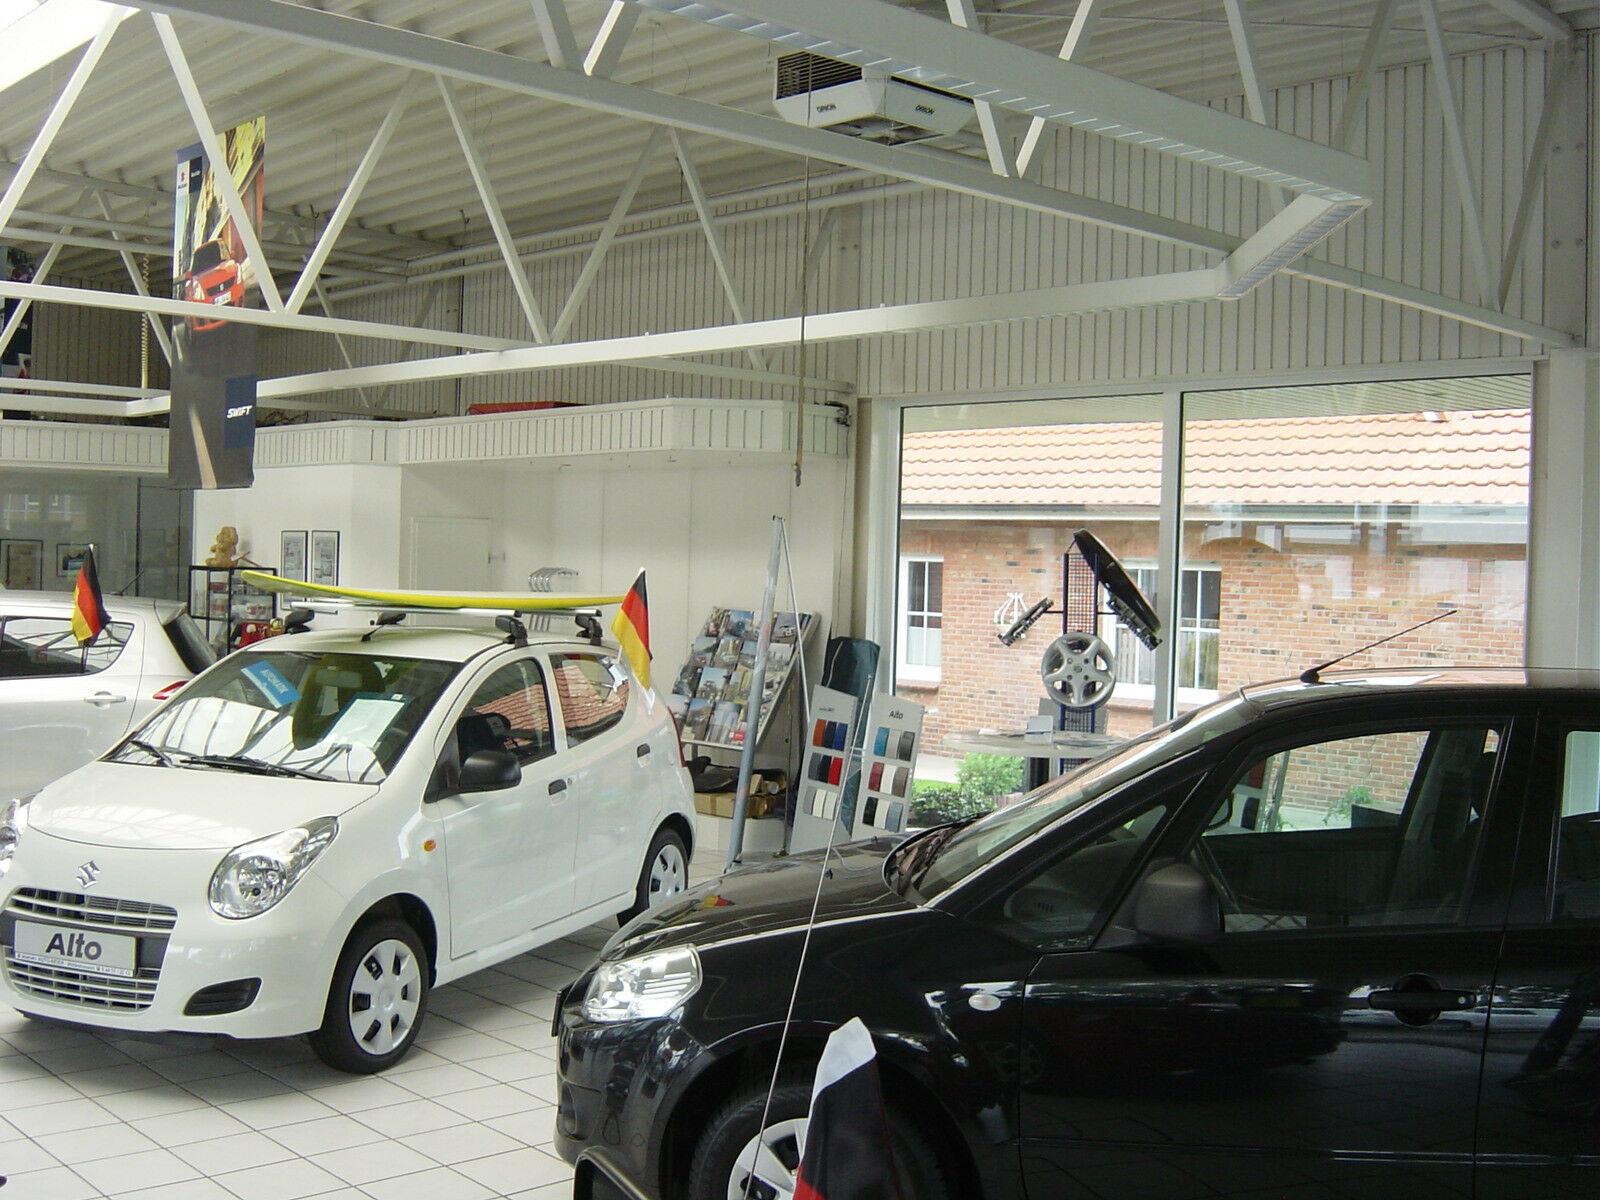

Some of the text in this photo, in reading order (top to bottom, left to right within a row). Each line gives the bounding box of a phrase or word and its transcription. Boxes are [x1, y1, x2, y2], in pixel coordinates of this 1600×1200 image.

[226, 405, 253, 418] SWIFT
[889, 710, 904, 720] Alto
[45, 932, 102, 960] Alto
